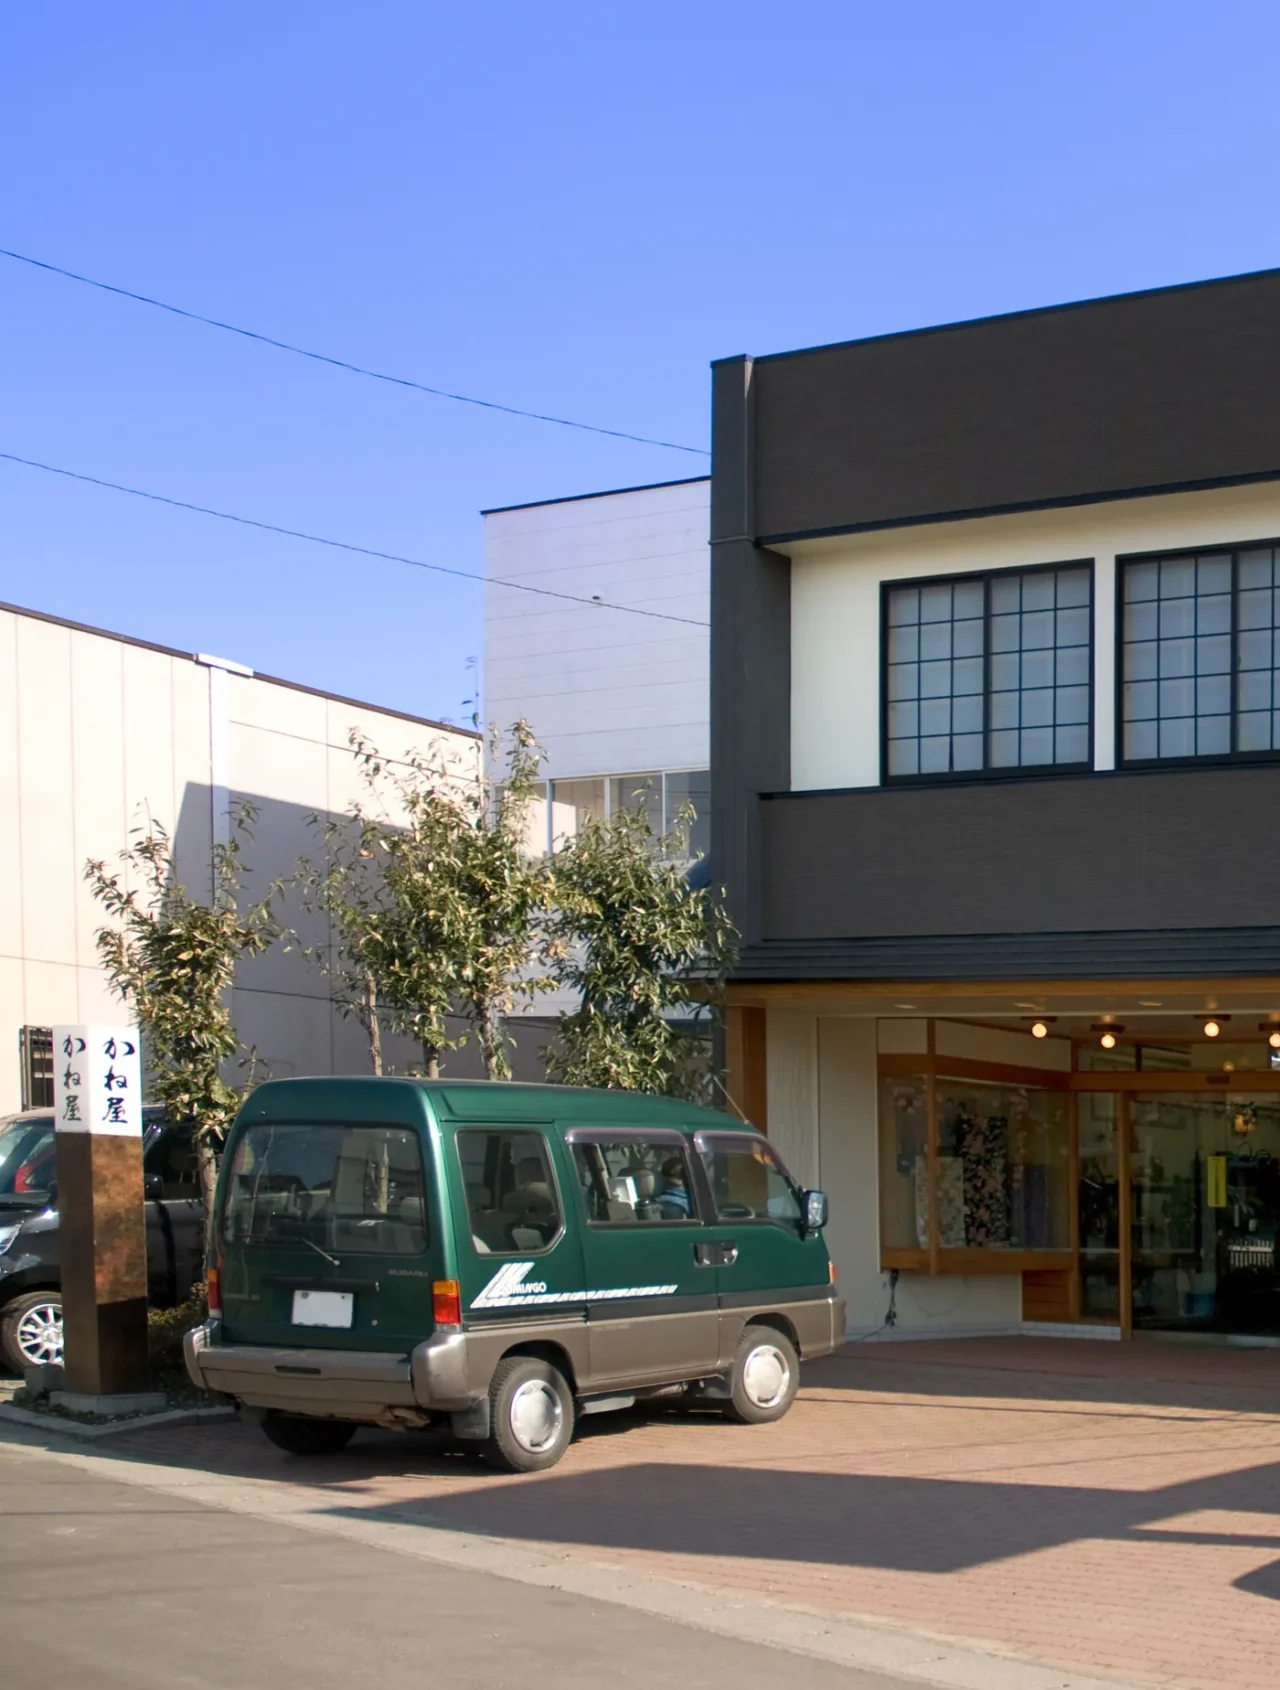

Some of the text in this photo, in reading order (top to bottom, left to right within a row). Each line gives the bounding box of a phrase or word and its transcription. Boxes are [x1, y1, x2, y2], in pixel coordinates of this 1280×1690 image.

[62, 1034, 87, 1122] かね屋
[102, 1036, 136, 1124] かね屋
